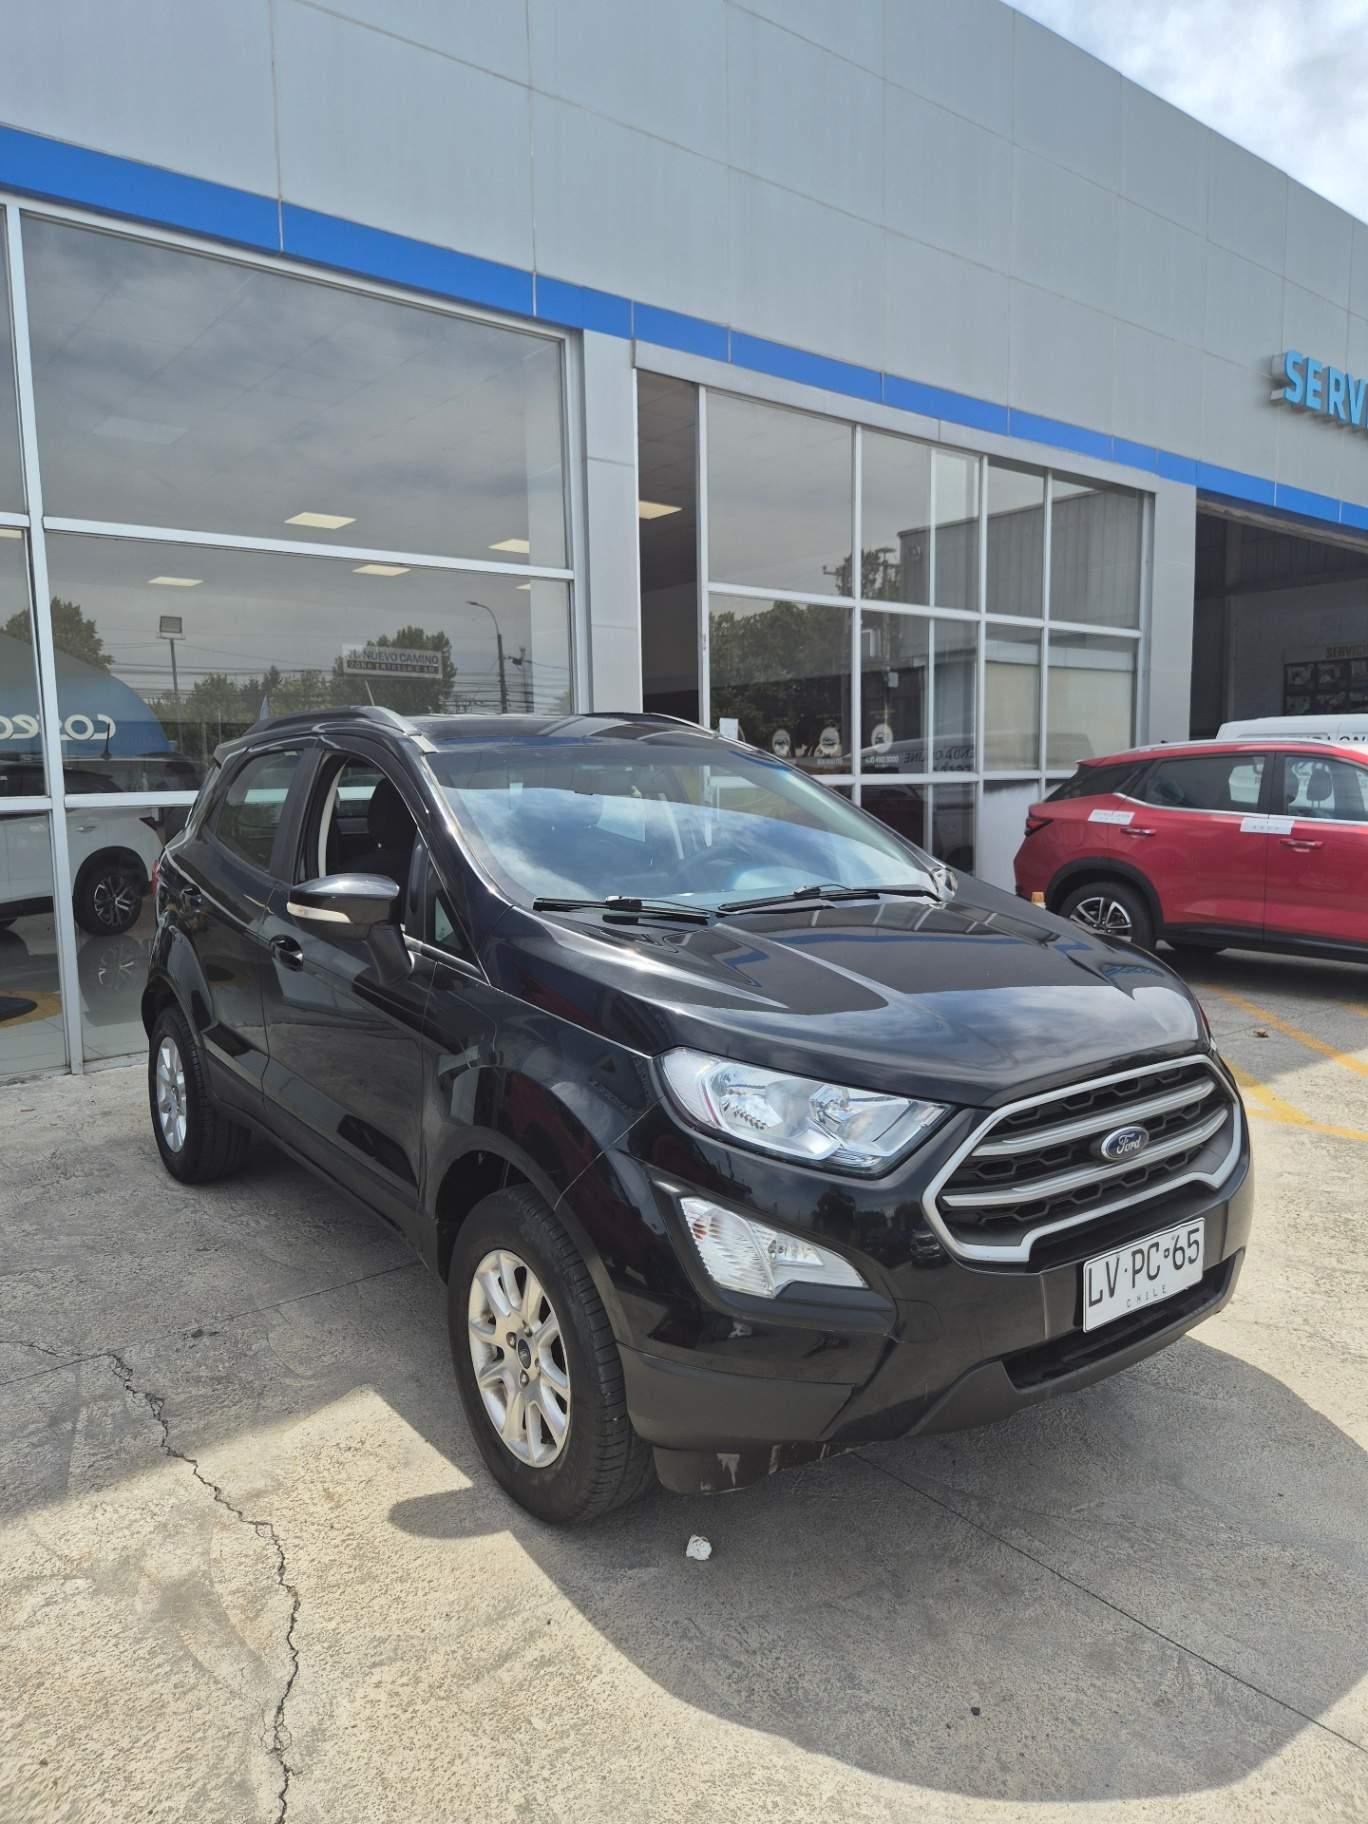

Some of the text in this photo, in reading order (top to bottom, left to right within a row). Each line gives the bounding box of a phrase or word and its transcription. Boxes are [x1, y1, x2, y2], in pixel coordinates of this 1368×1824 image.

[1284, 351, 1368, 428] SERV
[399, 653, 439, 665] CAMINO
[1116, 1133, 1142, 1154] Ford
[1126, 1284, 1167, 1308] CHILE
